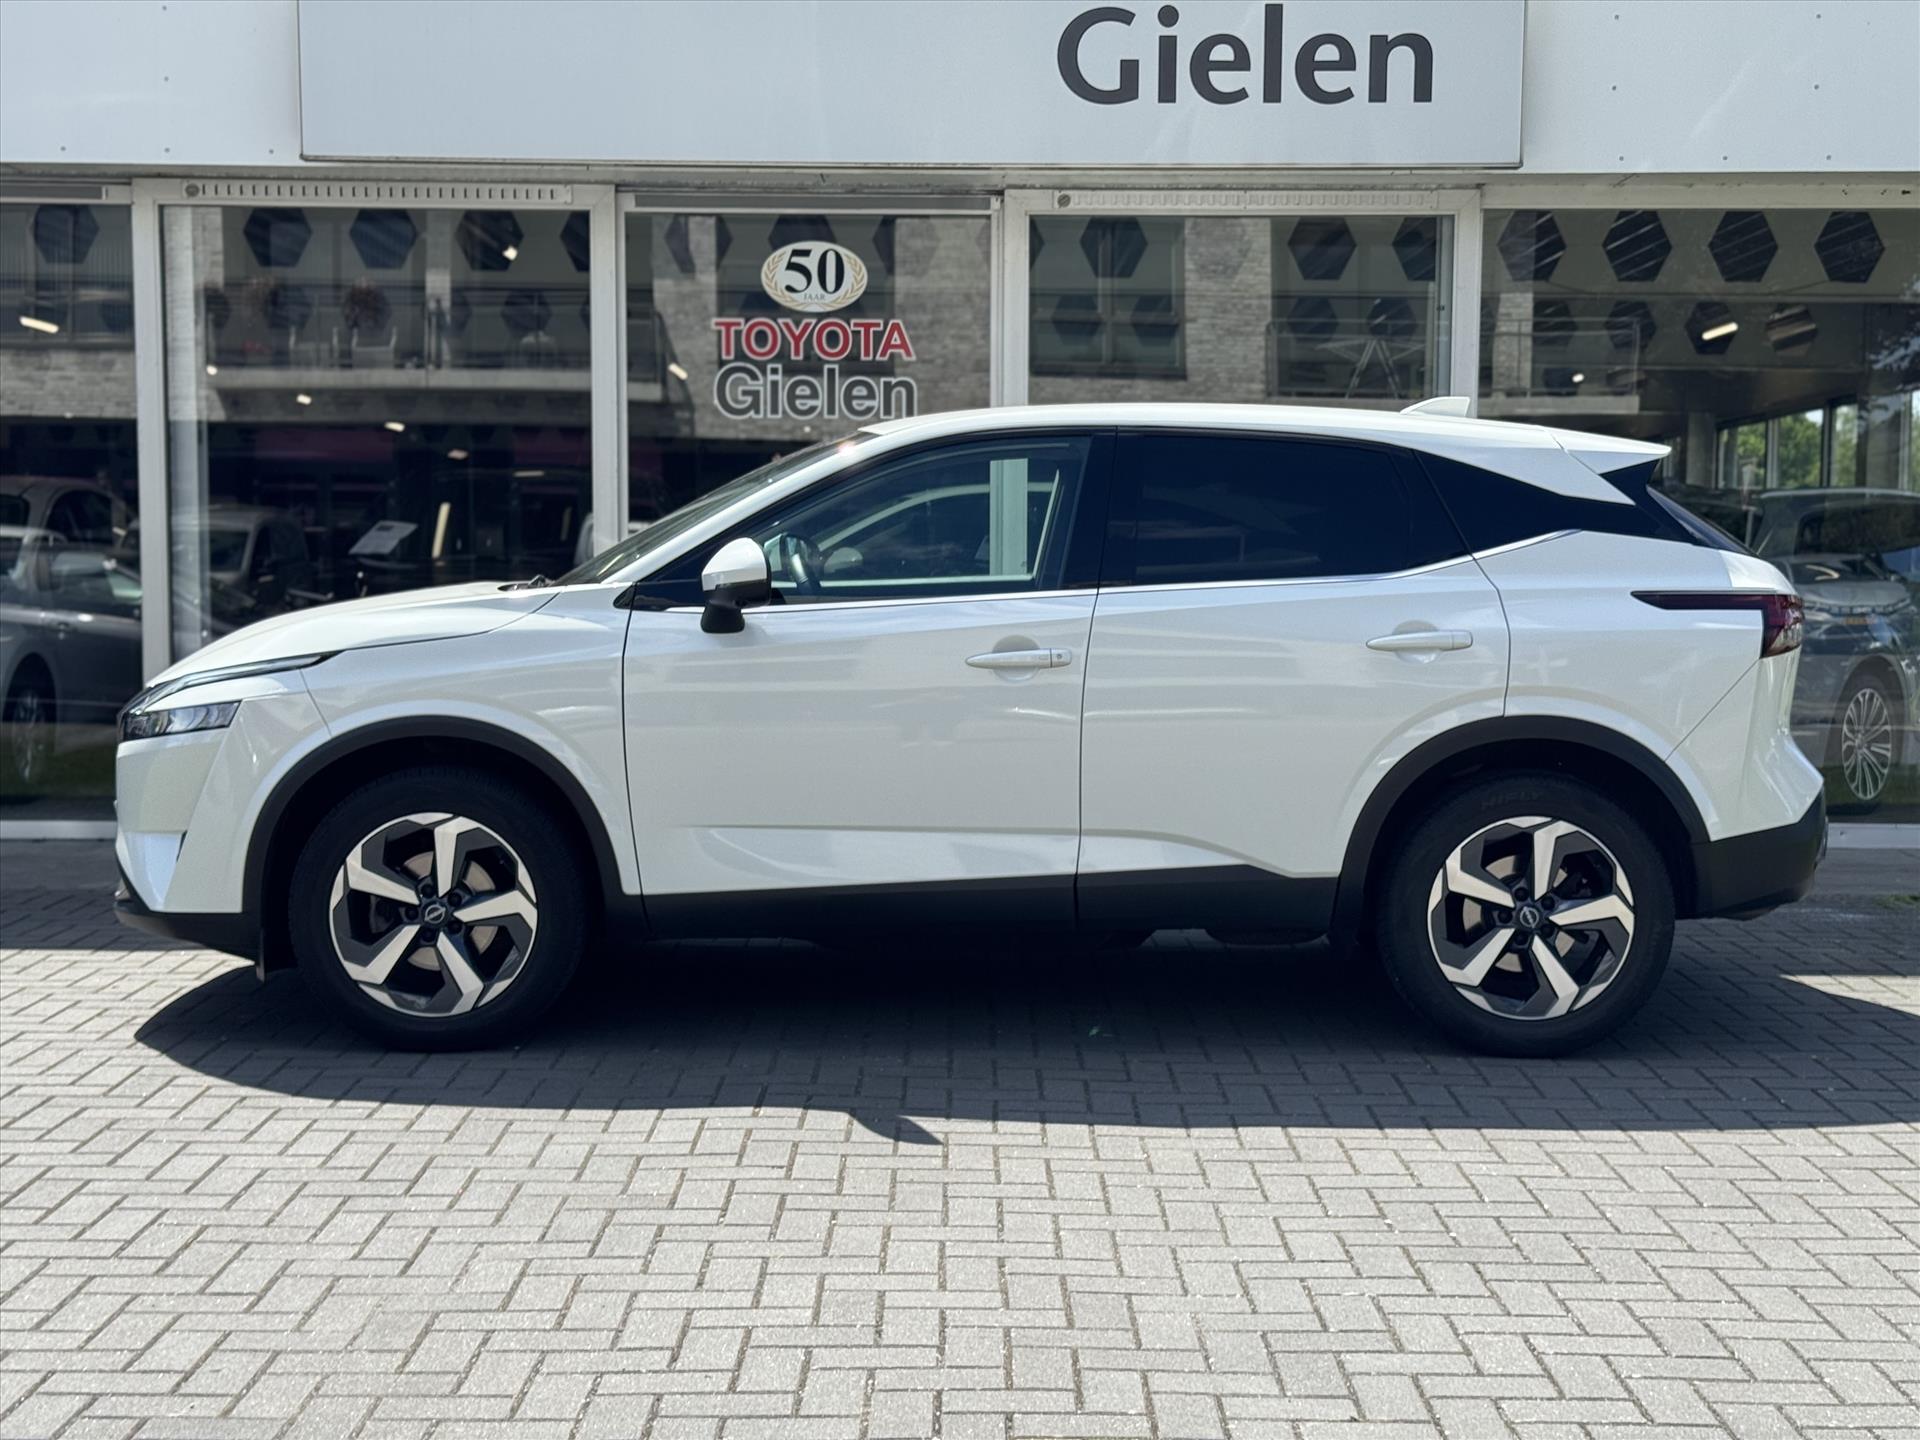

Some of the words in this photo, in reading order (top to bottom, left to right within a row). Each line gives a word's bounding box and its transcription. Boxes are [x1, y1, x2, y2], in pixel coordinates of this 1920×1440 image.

[1057, 3, 1433, 105] Gielen
[784, 248, 845, 295] 50
[803, 292, 826, 301] JAAR
[712, 318, 916, 361] TOYOTA
[714, 362, 917, 420] Gielen
